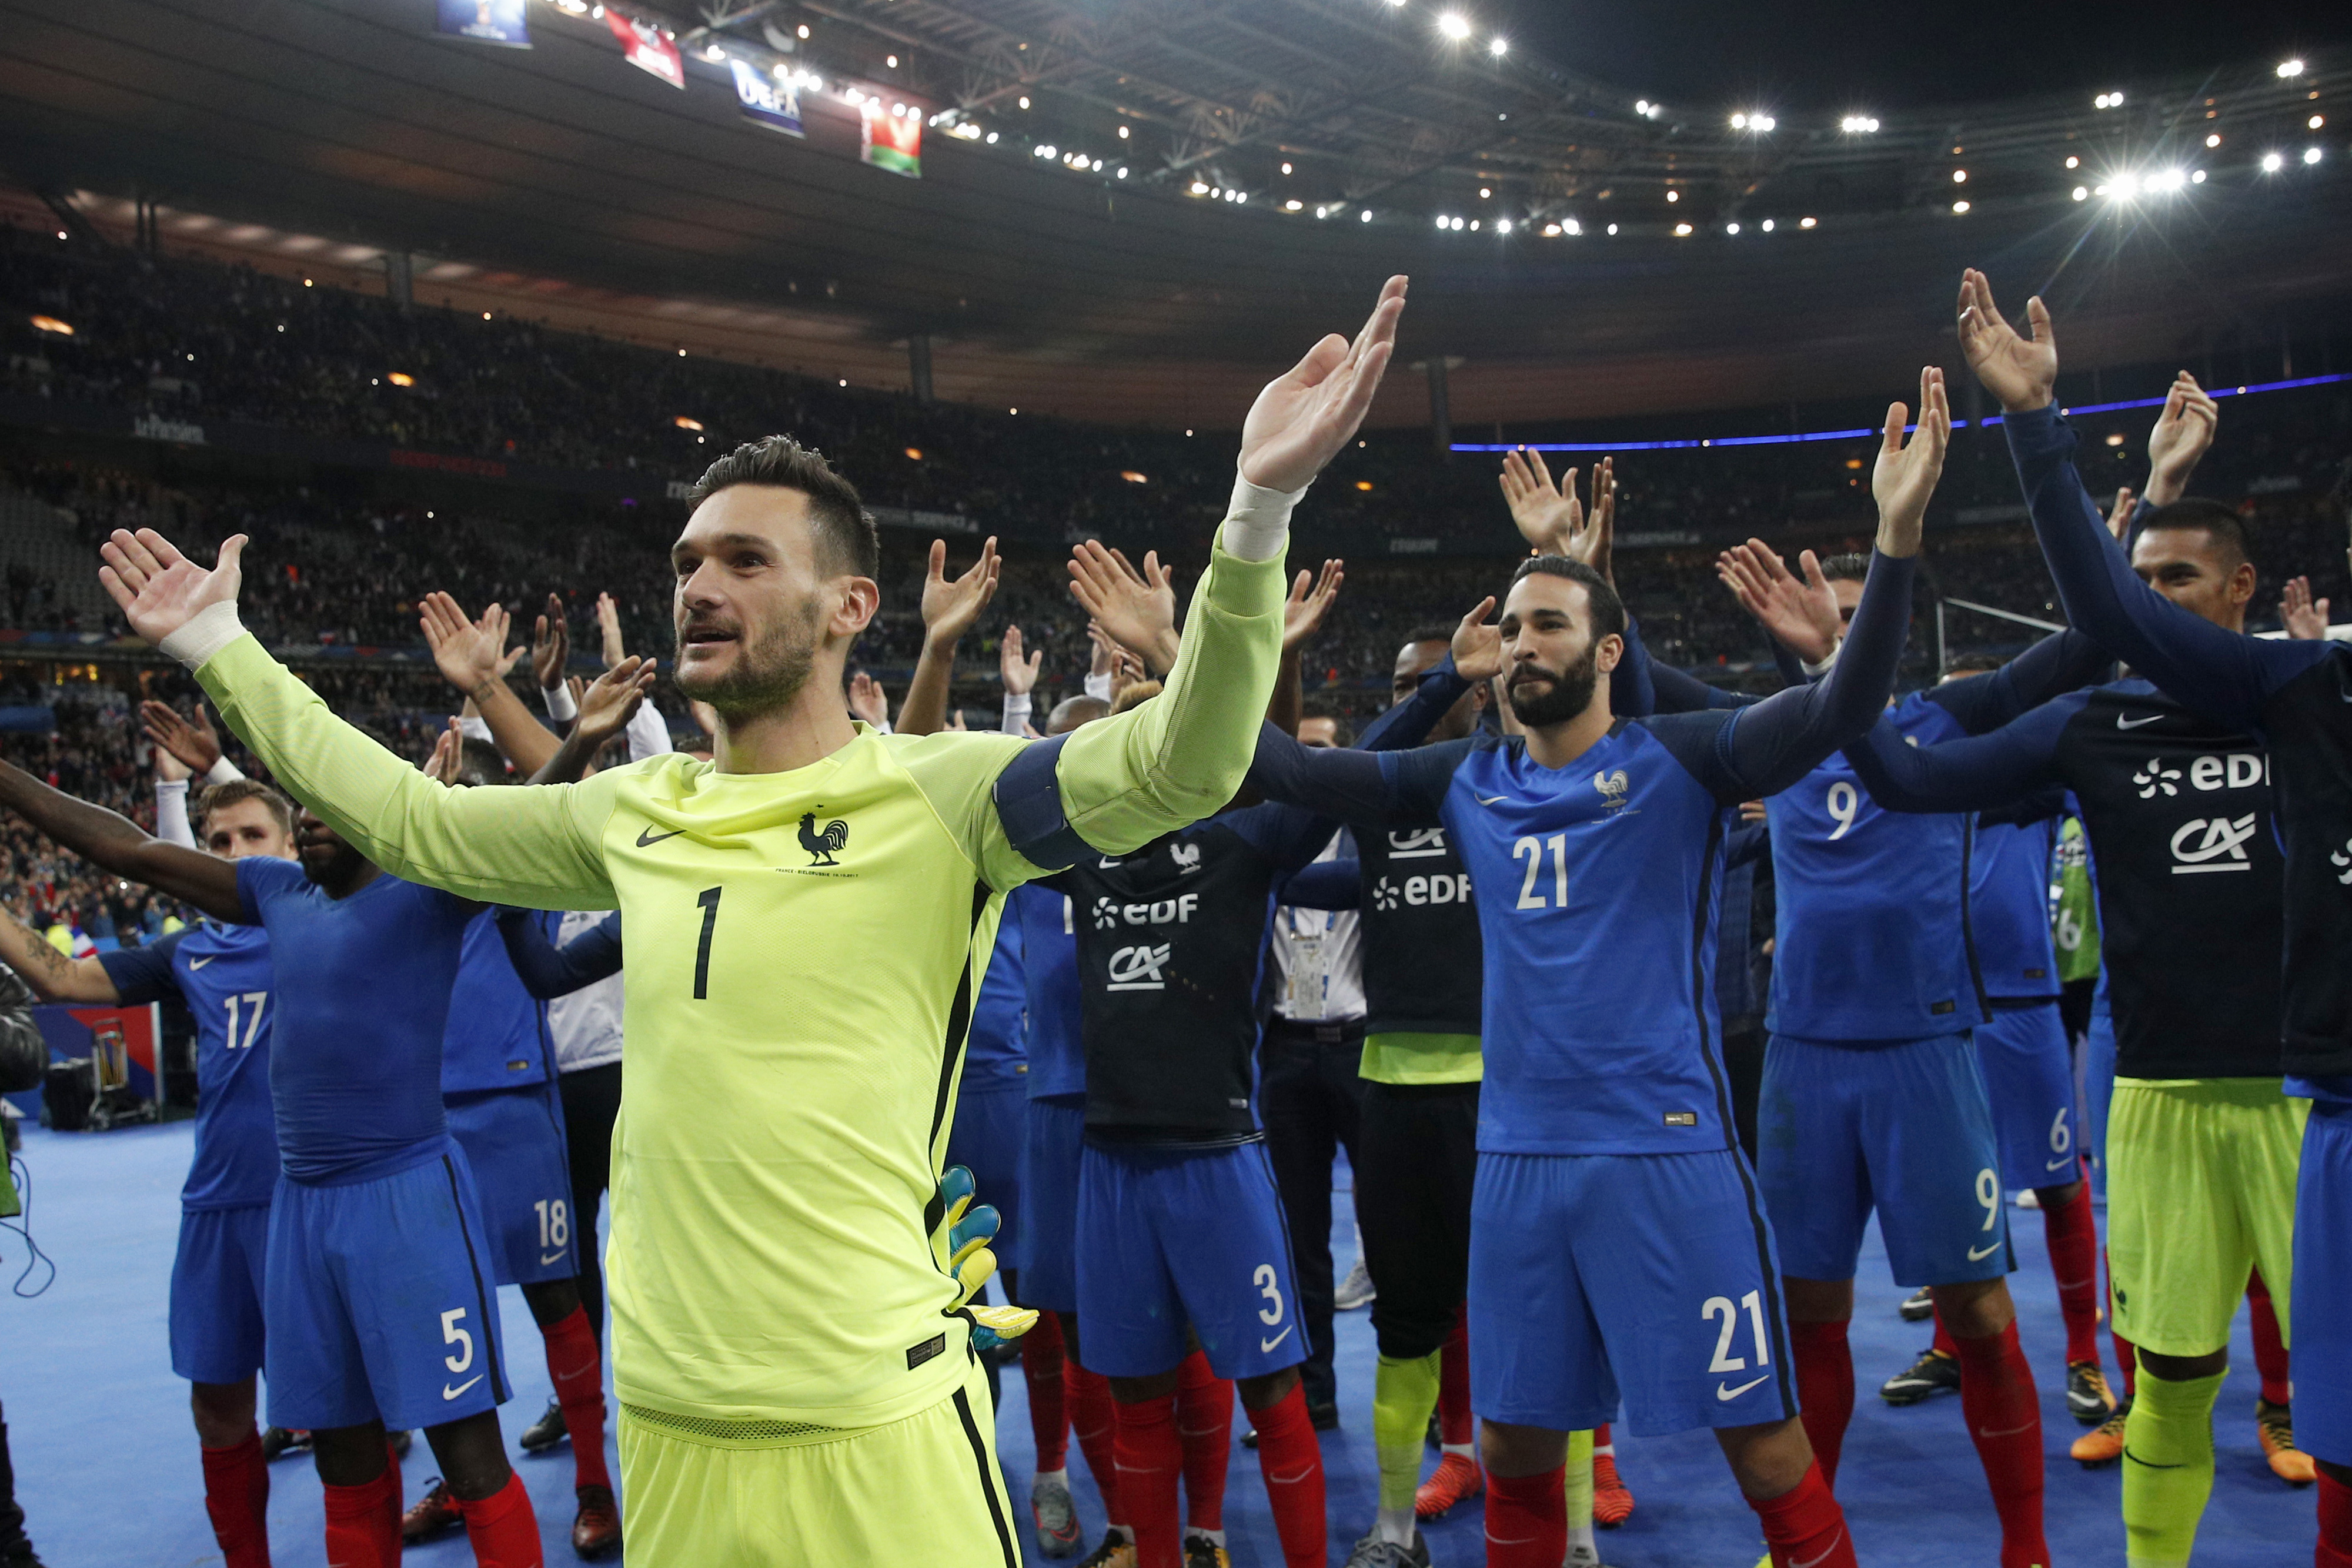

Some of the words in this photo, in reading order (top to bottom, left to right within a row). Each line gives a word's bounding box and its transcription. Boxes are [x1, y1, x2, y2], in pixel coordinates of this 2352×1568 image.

[737, 76, 800, 115] UEFA
[2190, 750, 2271, 791] eD
[1828, 782, 1857, 841] 9
[1512, 833, 1568, 910] 21
[694, 885, 722, 1000] 1
[225, 991, 267, 1049] 17
[2050, 1107, 2071, 1154] 6
[534, 1199, 569, 1248] 18
[1975, 1168, 1999, 1231] 9
[1253, 1263, 1284, 1326] 3
[440, 1307, 473, 1373] 5
[1702, 1289, 1769, 1373] 21
